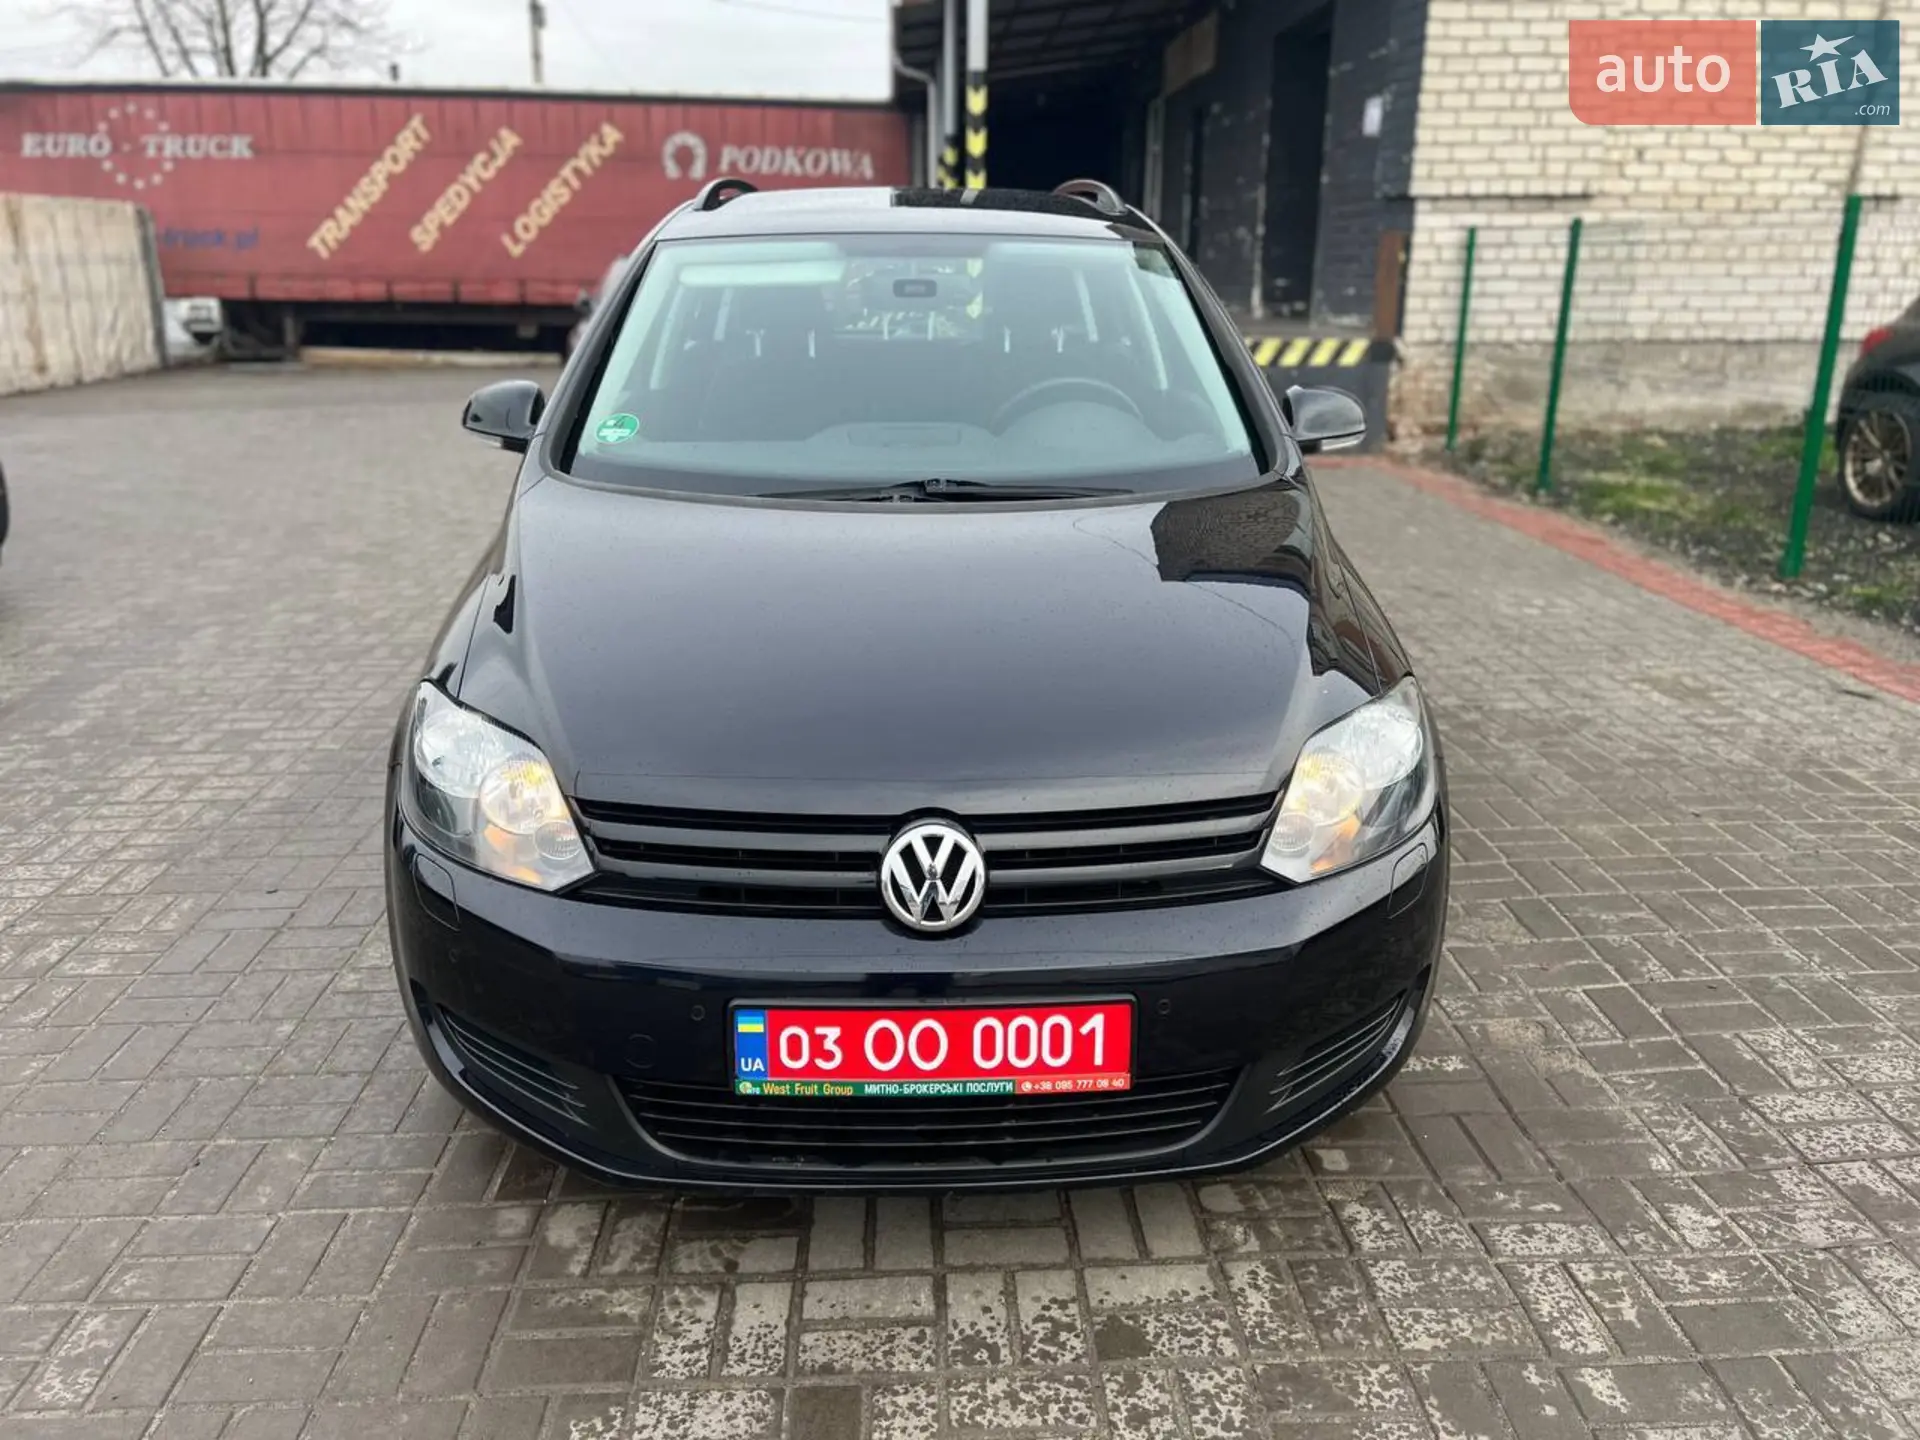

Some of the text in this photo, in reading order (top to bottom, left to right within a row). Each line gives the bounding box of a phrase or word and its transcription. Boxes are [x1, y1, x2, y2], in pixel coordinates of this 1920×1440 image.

[21, 133, 112, 158] EURO
[140, 133, 254, 159] TRUCK
[719, 145, 874, 180] PODKOWA
[307, 113, 431, 259] TRANSPORT
[409, 127, 523, 254] SPEDYCJA
[500, 121, 624, 258] LOGISTYKA
[779, 1025, 843, 1070] 03
[973, 1012, 1105, 1069] 0001
[741, 1058, 765, 1071] UA
[763, 1083, 791, 1095] West
[795, 1083, 818, 1095] Fruit
[823, 1083, 854, 1096] Group
[864, 1081, 1013, 1095] МИТНО-БРОКЕРСЬКІ ПОСЛУГИ
[1076, 1079, 1093, 1089] 777
